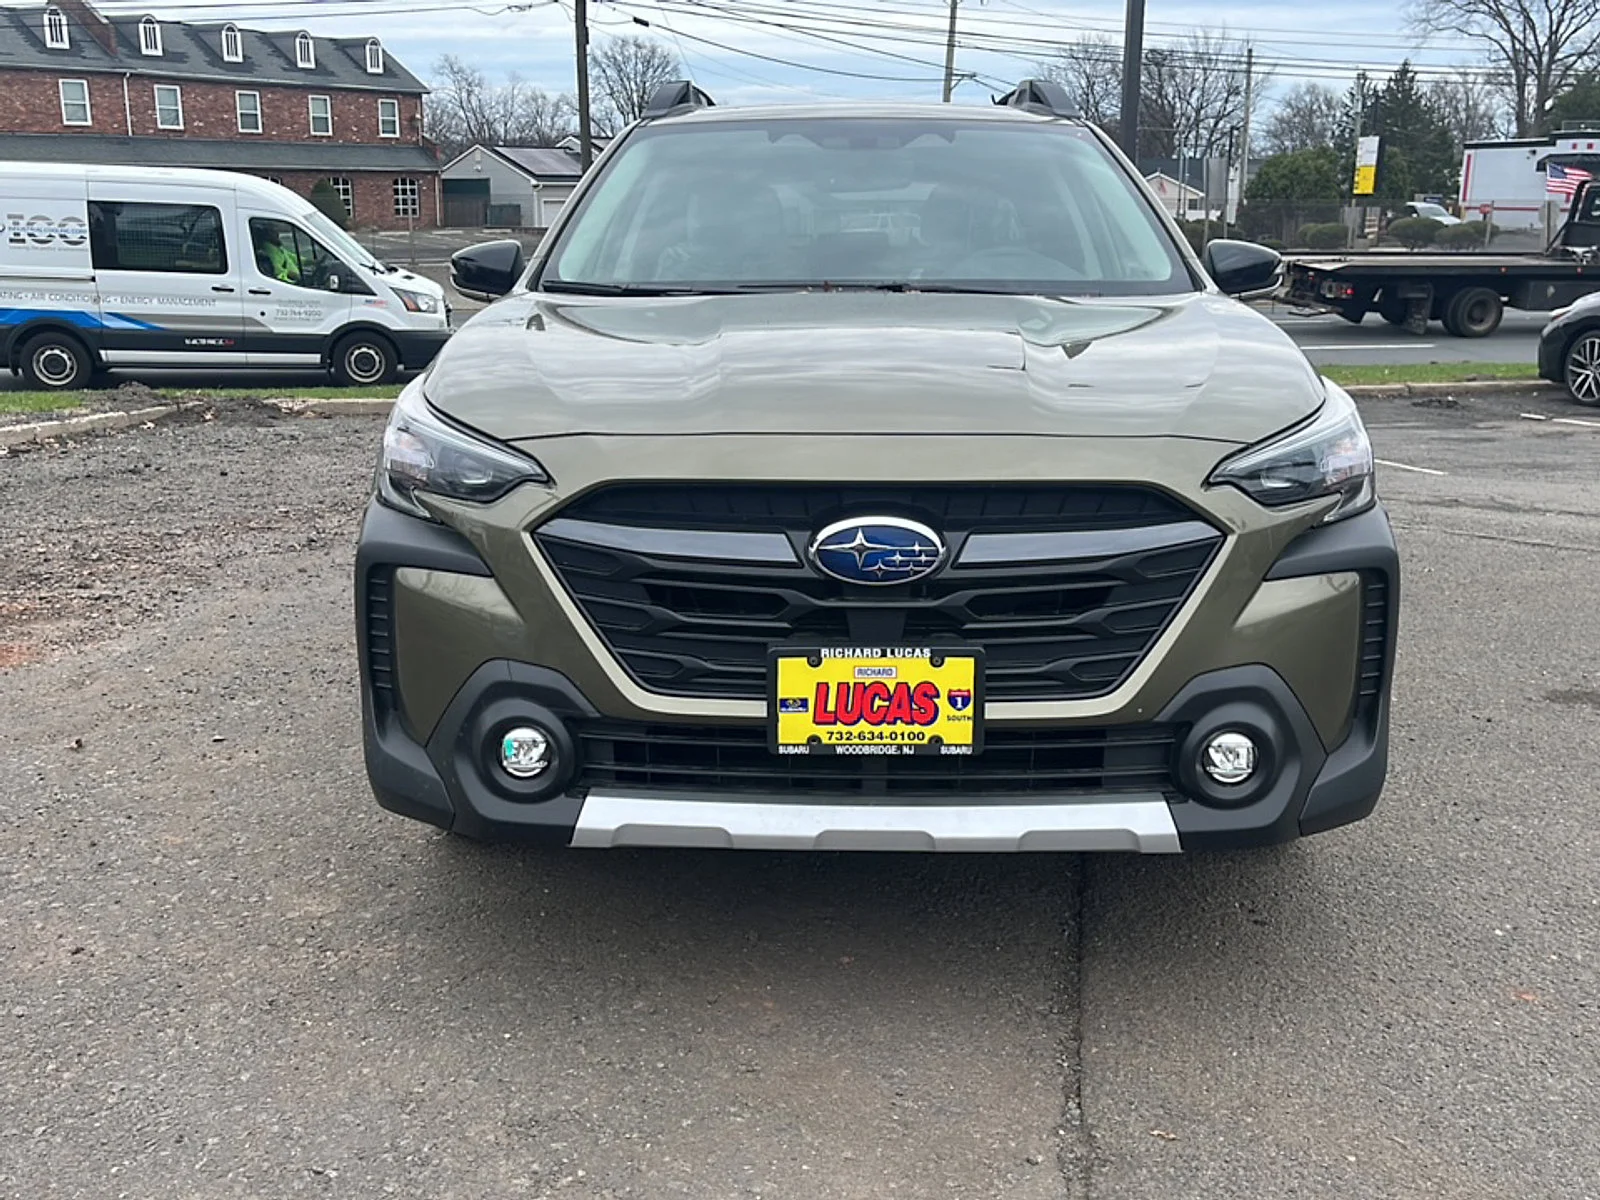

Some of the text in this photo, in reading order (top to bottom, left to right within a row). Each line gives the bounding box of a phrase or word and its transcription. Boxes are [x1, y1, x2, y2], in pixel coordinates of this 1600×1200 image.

[48, 293, 112, 303] CONDITIONG
[119, 295, 153, 305] ENERGY
[157, 297, 217, 307] MANAGEMENT
[821, 647, 932, 658] RICHARD LUCAS
[856, 667, 894, 677] RICHARD
[813, 681, 941, 726] LUCAS
[954, 696, 964, 709] 1
[826, 731, 926, 741] 732-634-0100
[778, 745, 810, 755] SUBARU
[902, 745, 915, 755] NJ
[940, 745, 973, 755] SUBARU
